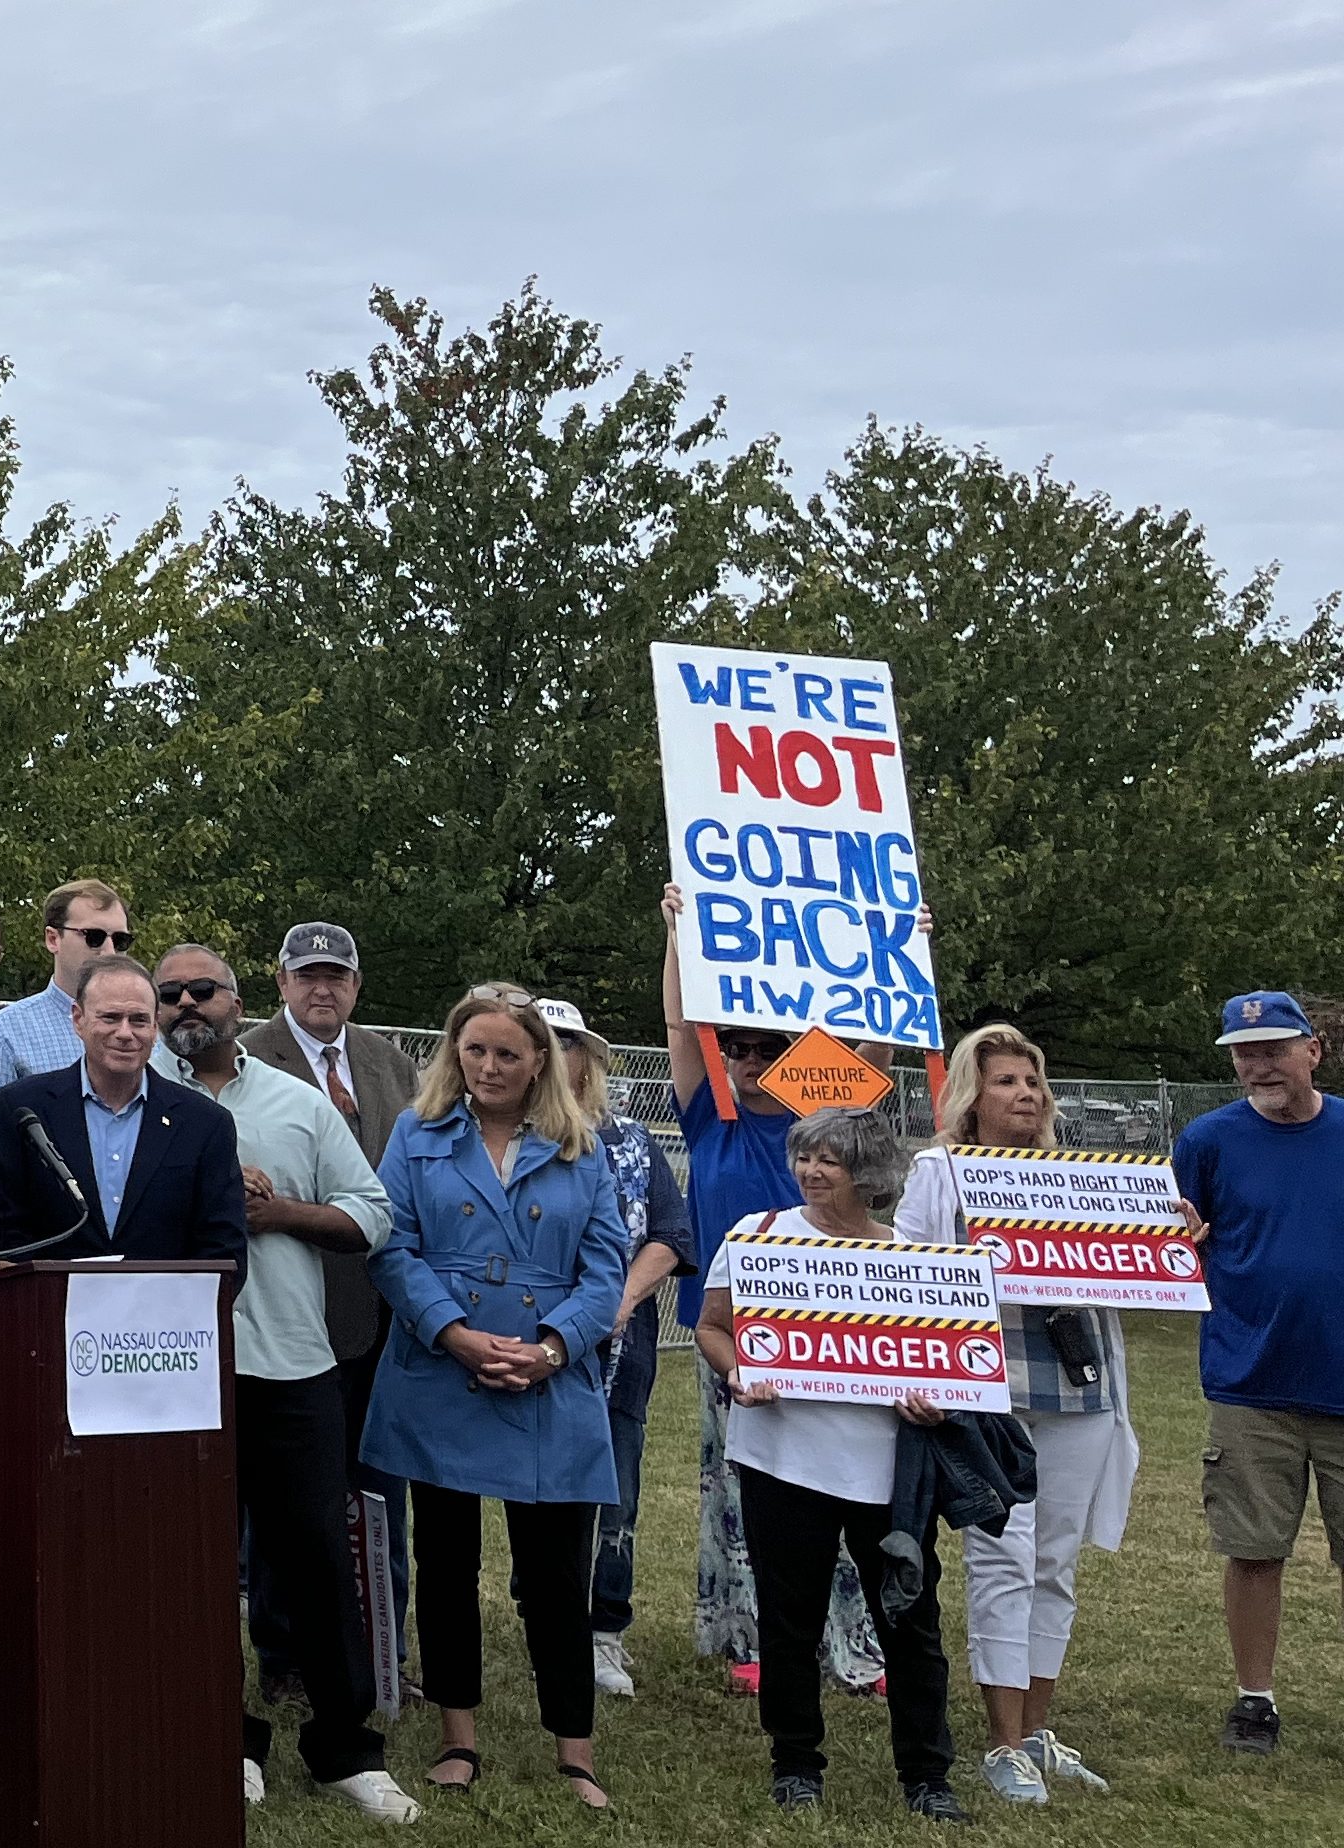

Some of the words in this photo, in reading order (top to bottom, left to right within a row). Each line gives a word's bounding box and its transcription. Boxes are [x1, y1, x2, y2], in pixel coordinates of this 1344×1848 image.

[677, 661, 887, 733] WE'RE
[714, 722, 896, 814] NOT
[684, 818, 920, 911] GOING
[694, 892, 935, 995] BACK
[823, 983, 941, 1048] 2024
[779, 1067, 869, 1083] ADVENTURE
[800, 1085, 853, 1101] AHEAD
[963, 1168, 1015, 1186] GOP'S
[1018, 1171, 1066, 1188] HARD
[1068, 1174, 1118, 1191] RIGHT
[1122, 1175, 1169, 1193] TURN
[963, 1190, 1028, 1208] WRONG
[1029, 1193, 1066, 1210] FOR
[1068, 1194, 1115, 1212] LONG
[740, 1255, 800, 1274] GOP'S
[805, 1259, 858, 1277] HARD
[864, 1262, 923, 1281] RIGHT
[927, 1265, 981, 1285] TURN
[1014, 1238, 1158, 1274] DANGER
[735, 1278, 810, 1298] WRONG
[814, 1283, 854, 1301] FOR
[858, 1285, 913, 1304] LONG
[919, 1288, 991, 1309] ISLAND
[1076, 1287, 1153, 1301] CANDIDATES
[1155, 1290, 1187, 1303] ONLY
[76, 1338, 93, 1354] NC
[101, 1331, 156, 1351] NASSAU
[158, 1330, 214, 1350] COUNTY
[787, 1330, 952, 1371] DANGER
[76, 1354, 93, 1370] DC
[101, 1351, 199, 1374] DEMOCRATS
[944, 1388, 982, 1403] ONLY
